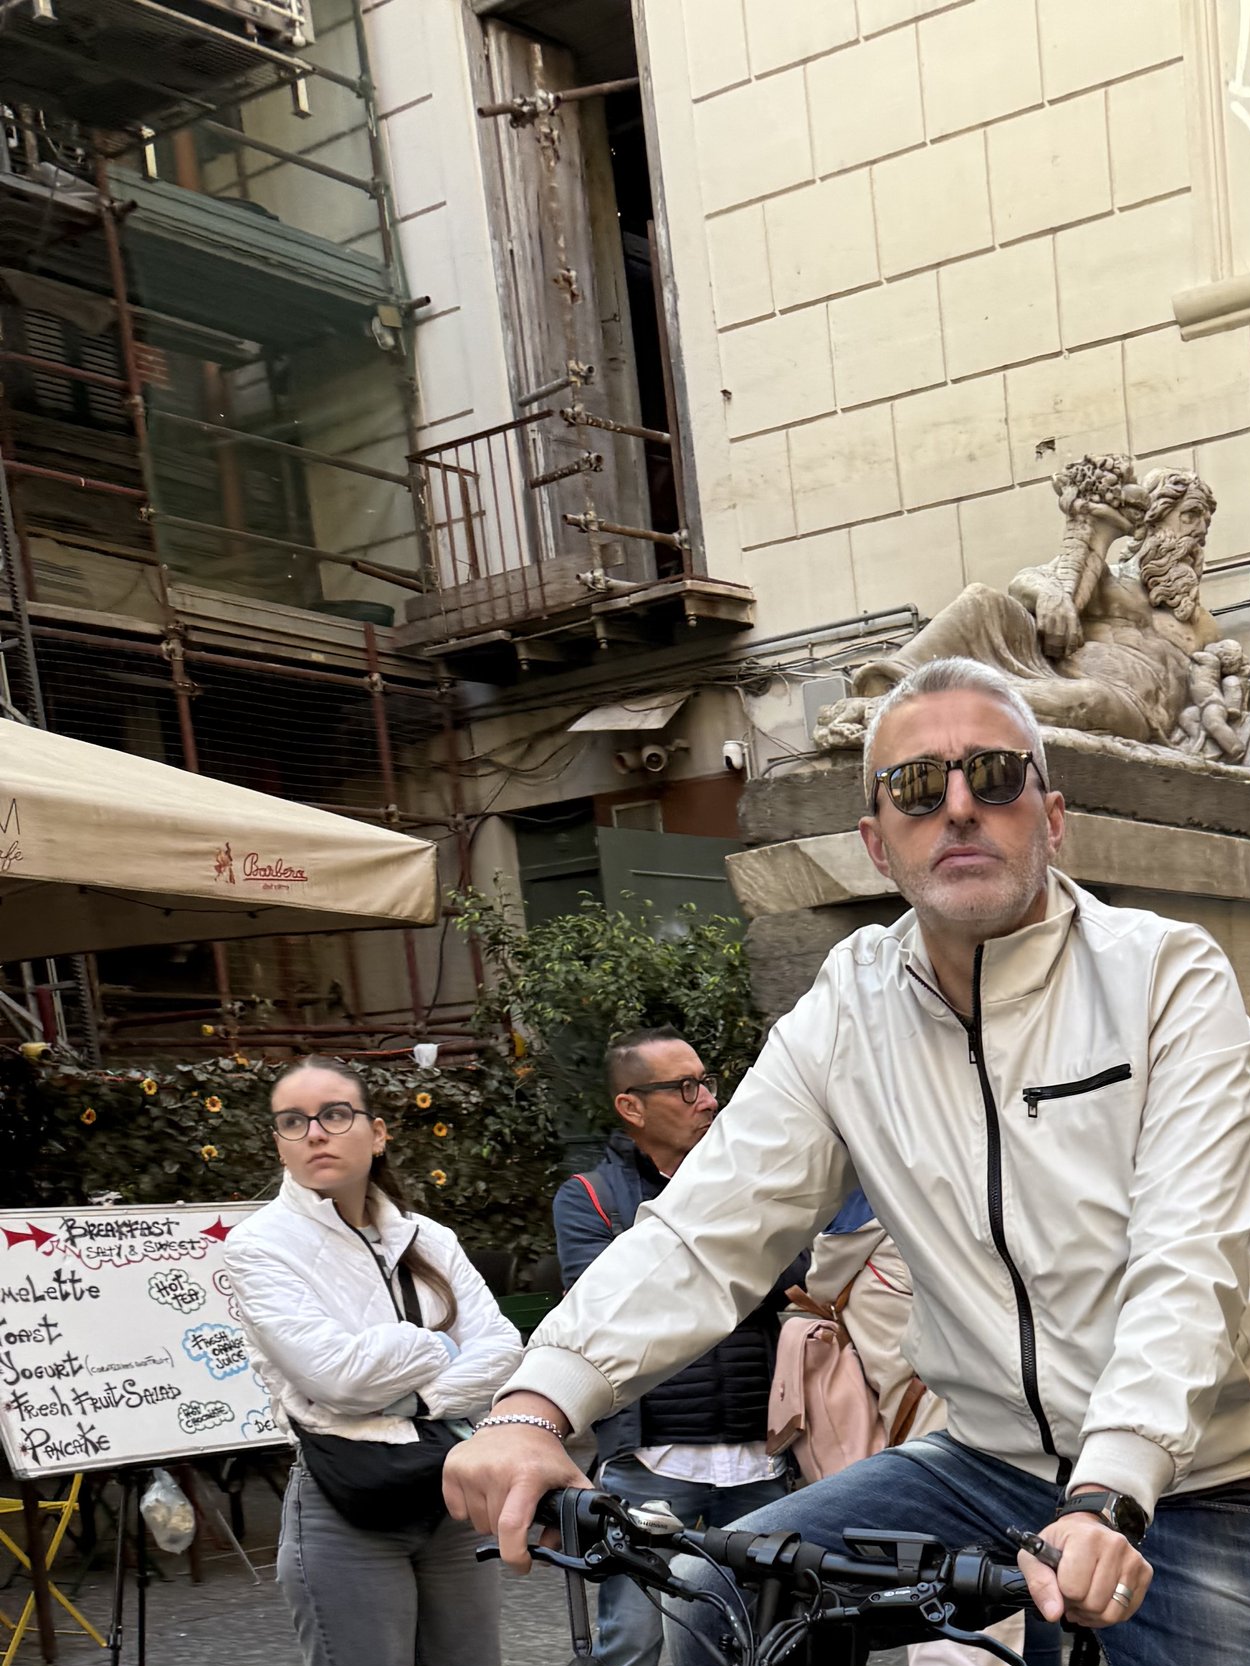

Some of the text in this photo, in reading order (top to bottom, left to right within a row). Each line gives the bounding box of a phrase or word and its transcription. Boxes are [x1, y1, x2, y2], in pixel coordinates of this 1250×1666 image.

[243, 853, 307, 880] Barbera
[59, 1217, 180, 1247] BREAKFAST
[143, 1238, 201, 1253] SWEET
[155, 1274, 184, 1297] HOT
[172, 1289, 200, 1307] TEA
